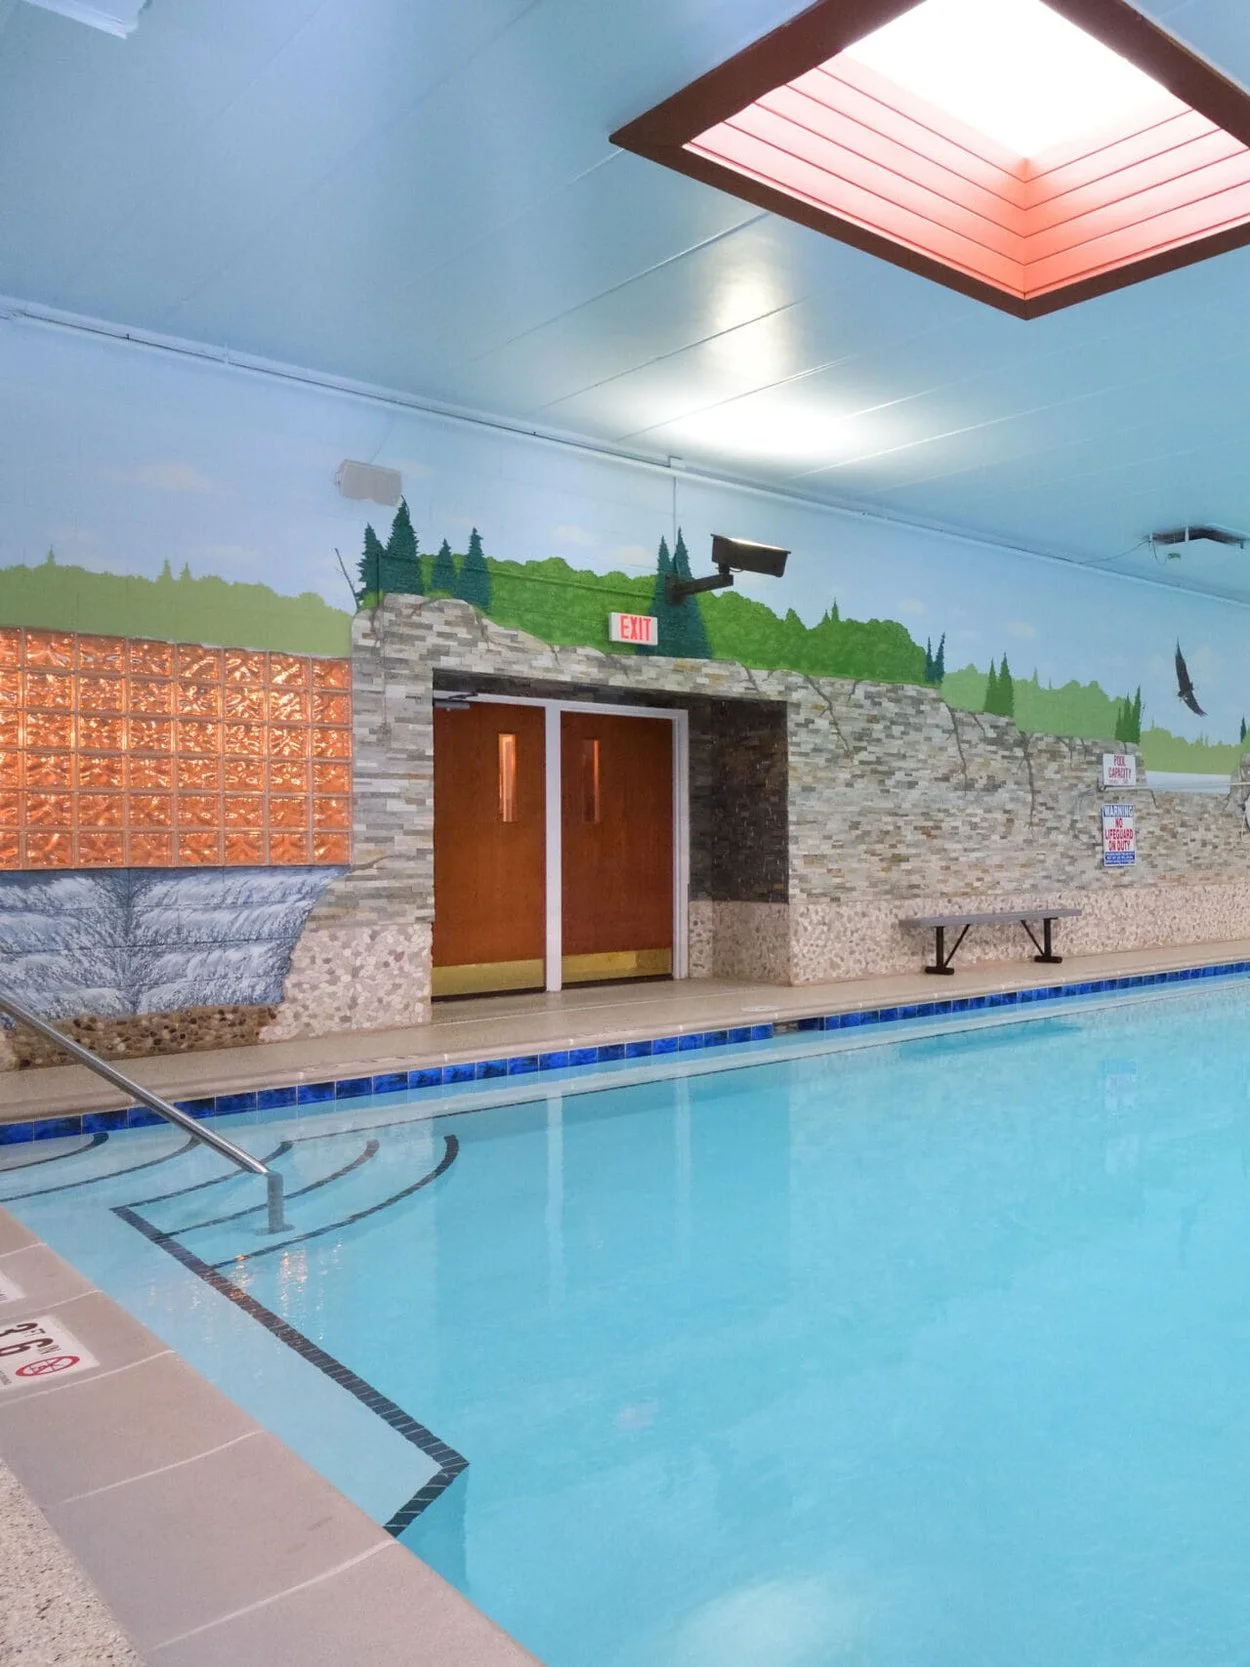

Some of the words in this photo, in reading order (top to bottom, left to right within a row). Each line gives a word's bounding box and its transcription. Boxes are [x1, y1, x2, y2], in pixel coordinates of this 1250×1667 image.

[620, 615, 651, 641] EXIT
[1113, 754, 1126, 767] POOL
[1108, 767, 1131, 779] CAPACITY
[1103, 804, 1134, 817] WARNING
[1115, 818, 1123, 828] NO
[1105, 828, 1134, 840] LIFEGUARD
[1108, 840, 1116, 850] ON
[1117, 840, 1131, 851] DUTY
